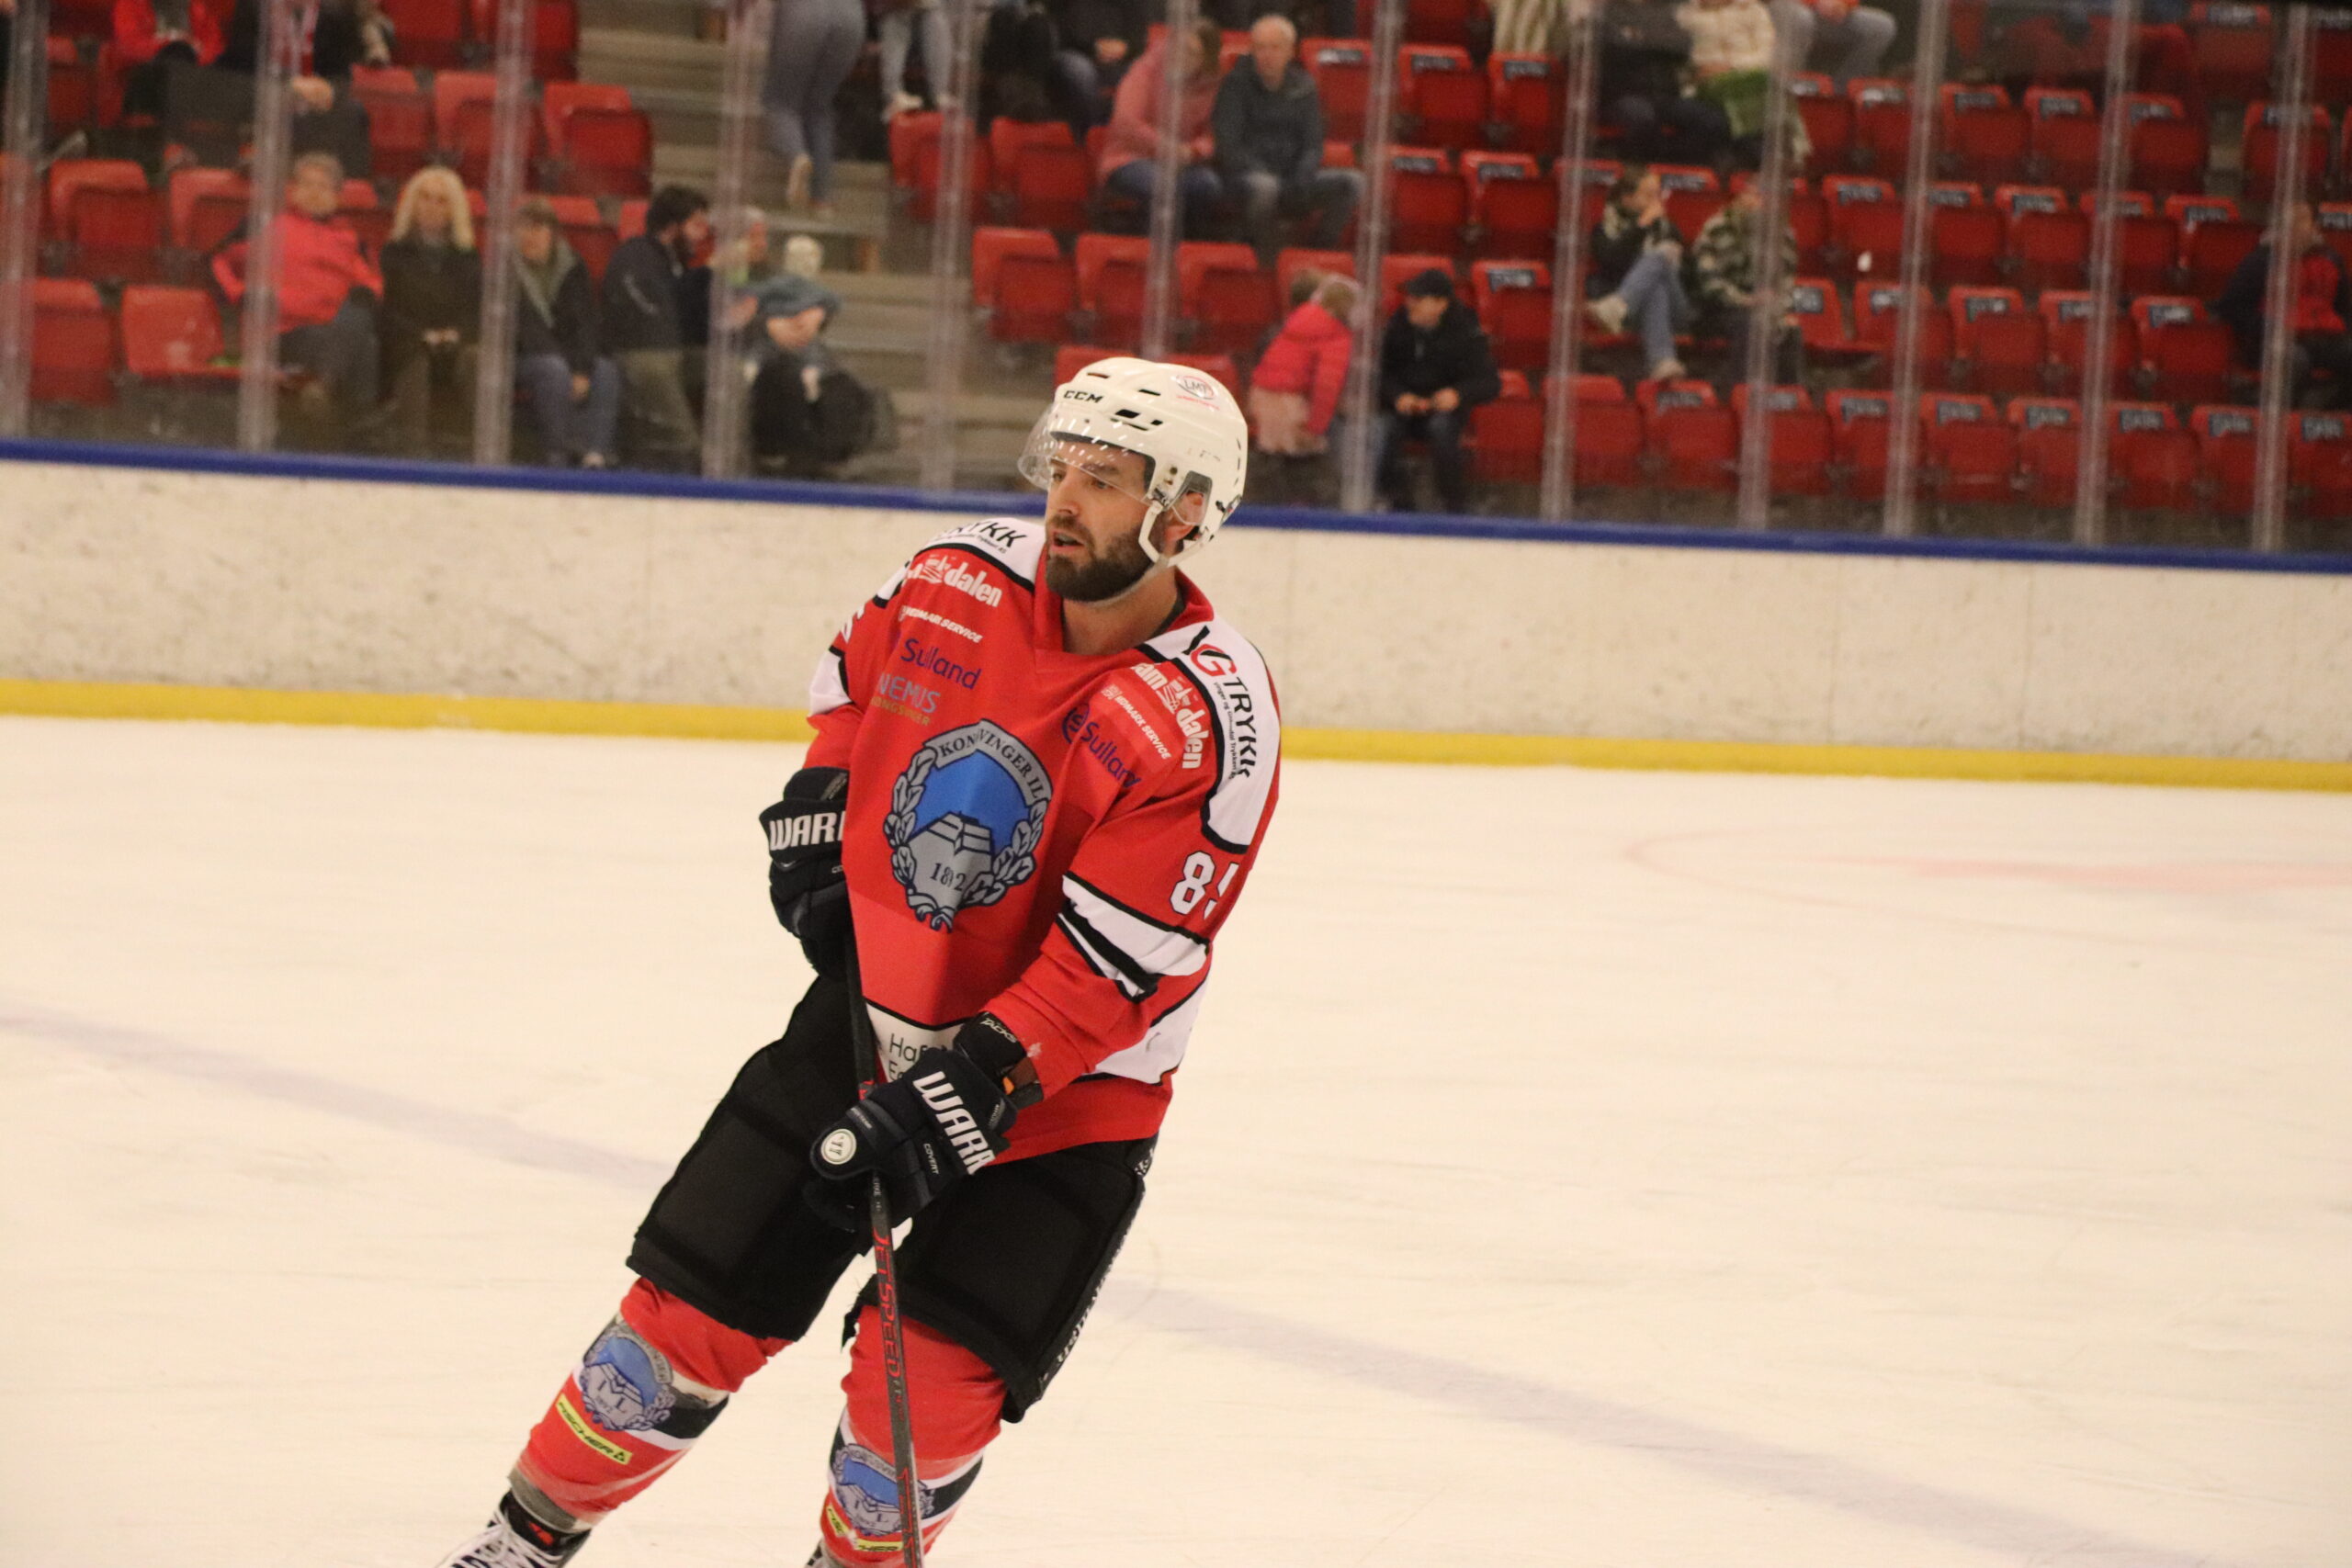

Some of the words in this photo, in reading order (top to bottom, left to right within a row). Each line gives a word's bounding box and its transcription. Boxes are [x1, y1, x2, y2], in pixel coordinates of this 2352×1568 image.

[1063, 389, 1104, 404] CCM
[940, 618, 984, 644] SERVICE
[1141, 725, 1172, 761] SERVICE
[1028, 779, 1045, 799] IL
